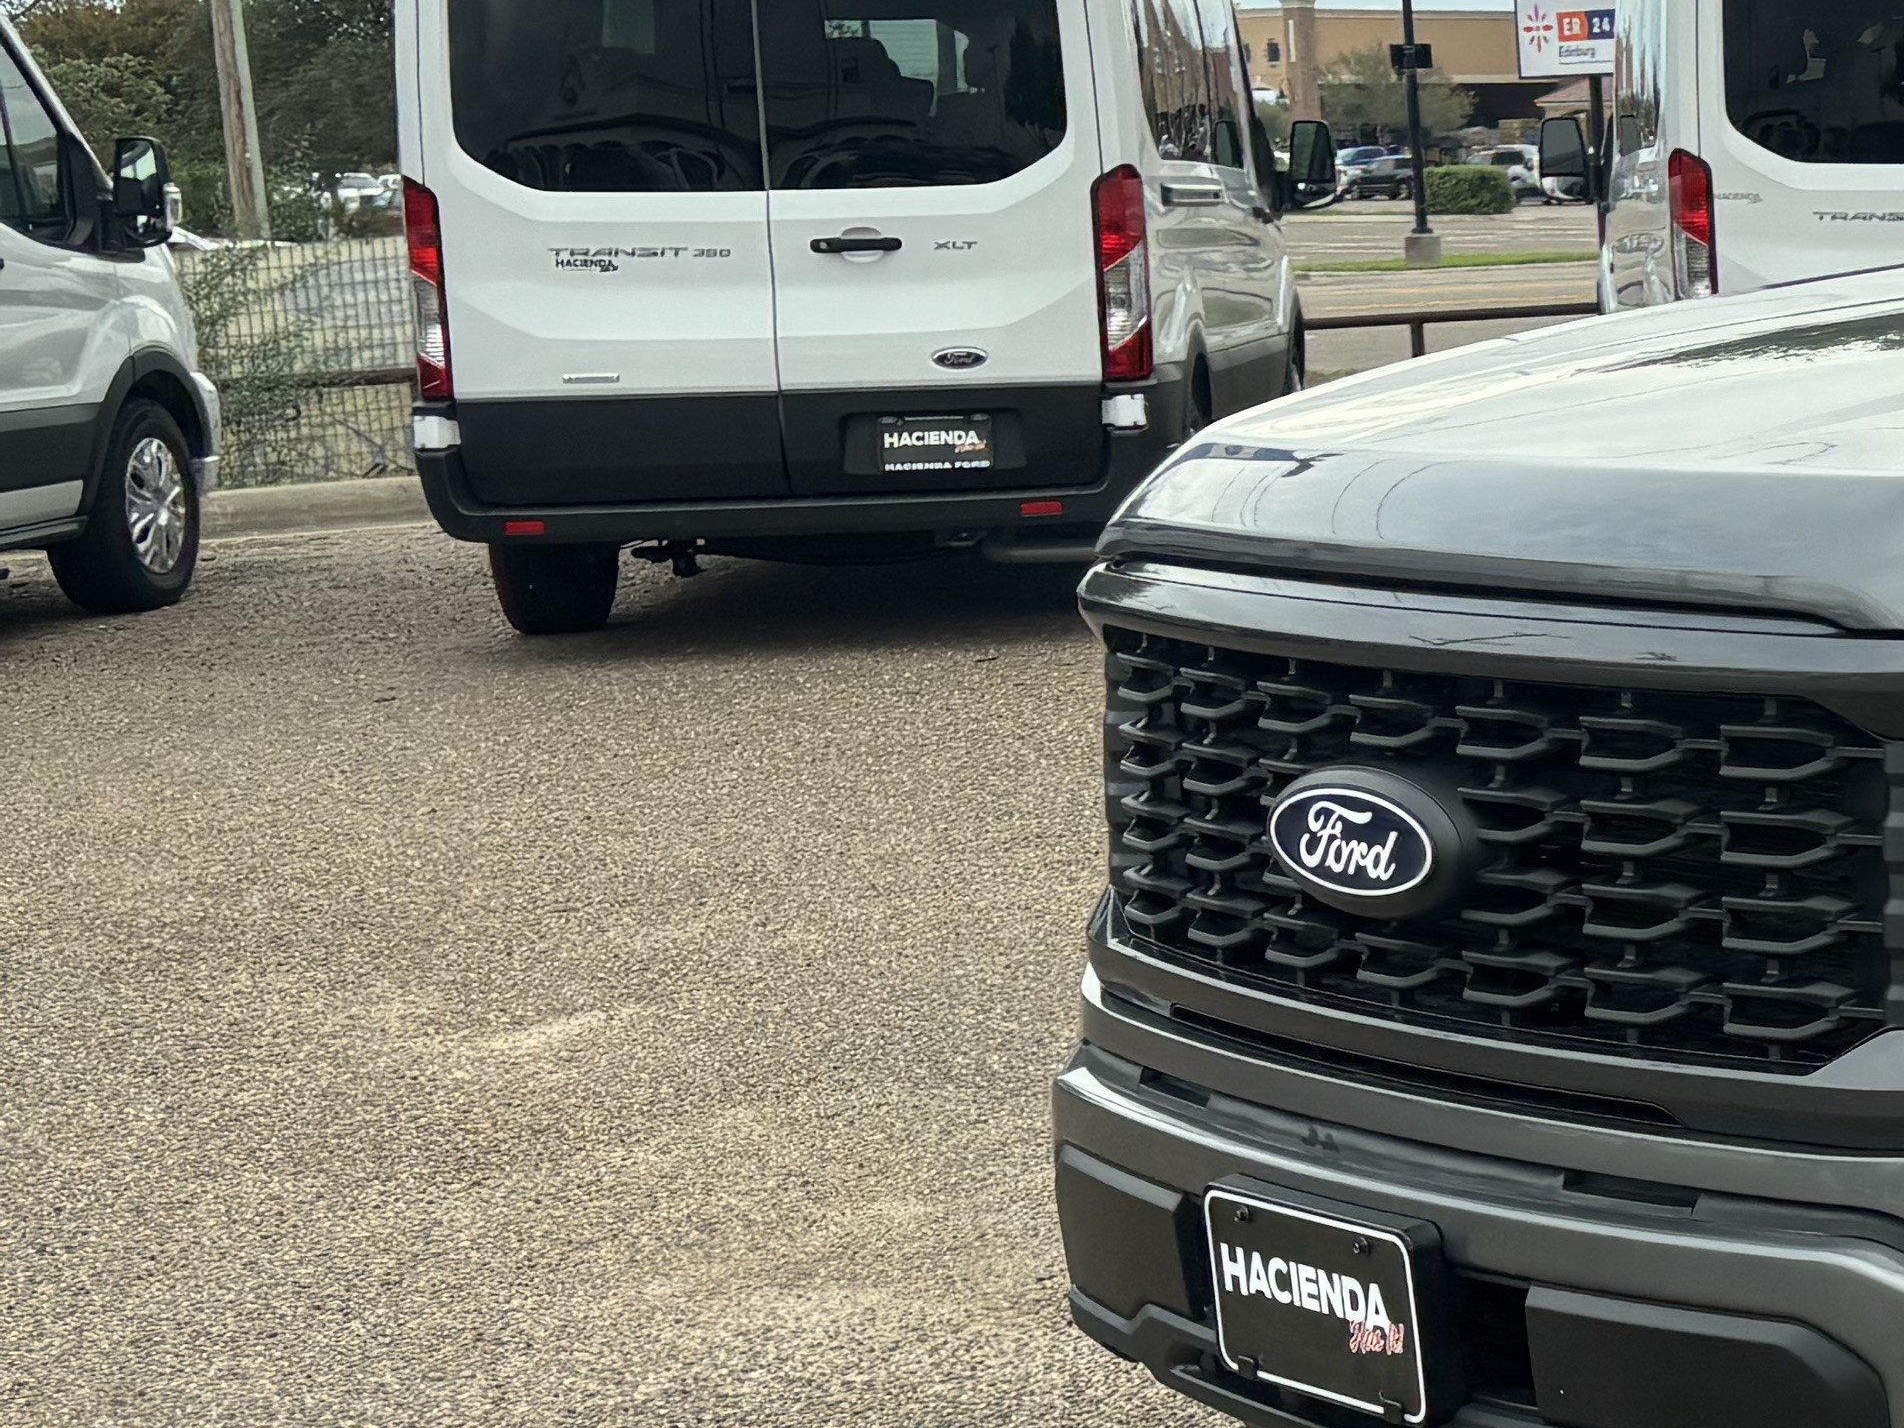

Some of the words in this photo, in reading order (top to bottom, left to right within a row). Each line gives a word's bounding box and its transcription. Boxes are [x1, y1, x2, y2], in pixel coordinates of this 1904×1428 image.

[1562, 17, 1581, 36] ER
[548, 247, 689, 258] TRANSIT
[933, 240, 979, 251] XLT
[555, 258, 614, 269] HACIENDA
[883, 430, 979, 448] HACIENDA
[1299, 800, 1399, 882] Ford
[1220, 1242, 1392, 1336] HACIENDA
